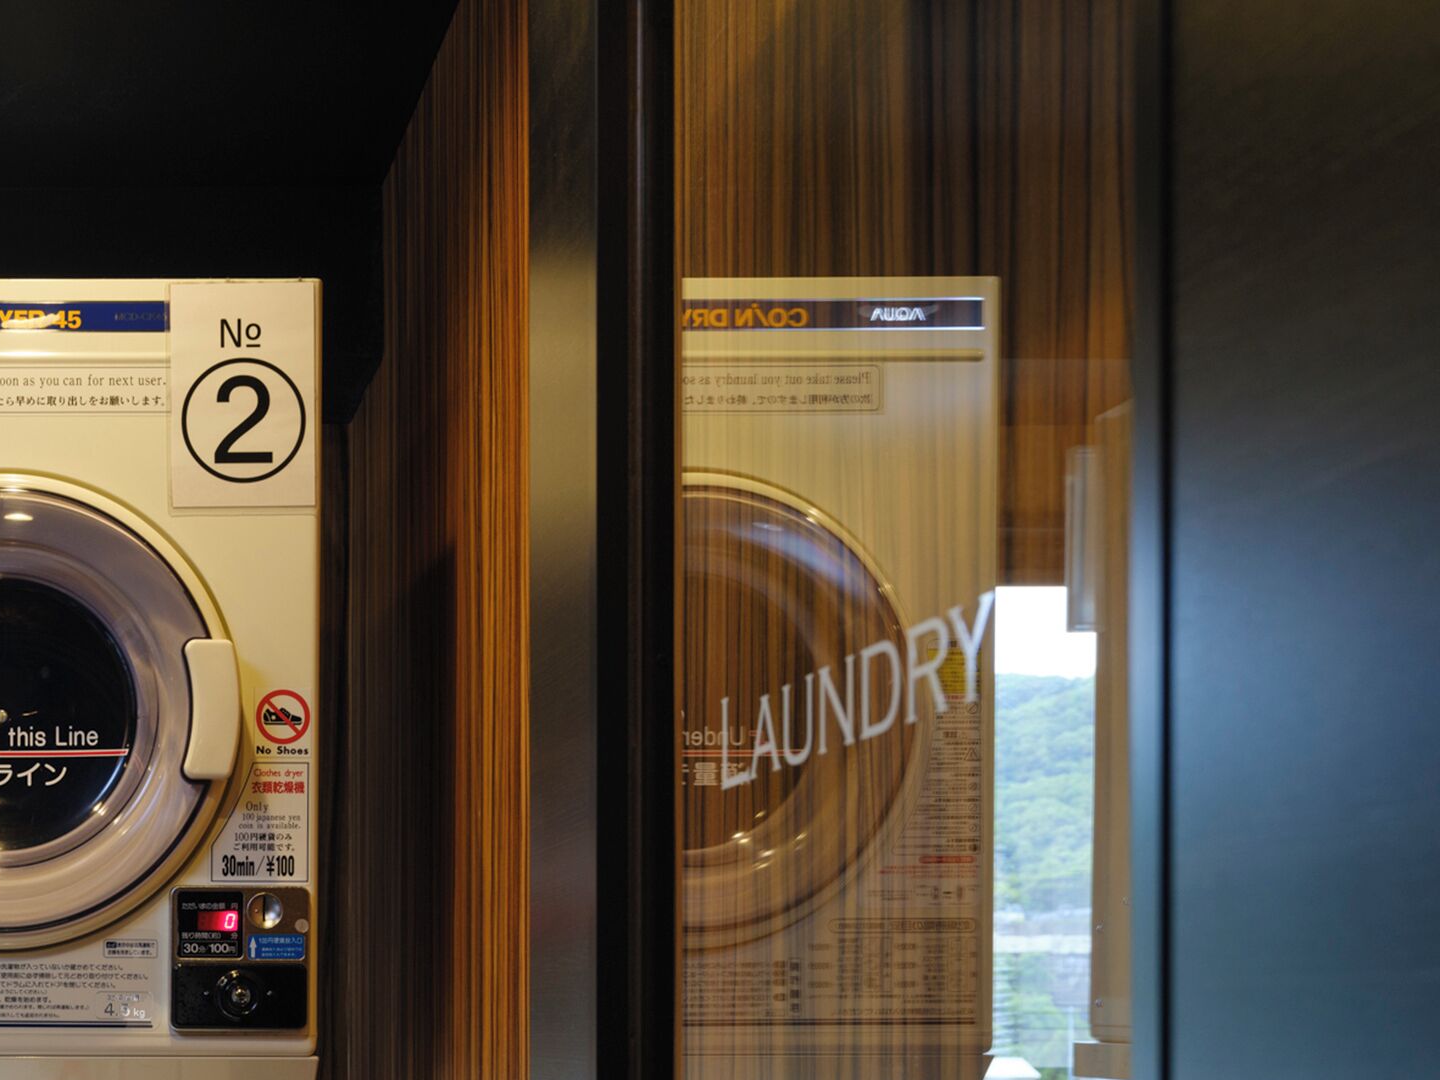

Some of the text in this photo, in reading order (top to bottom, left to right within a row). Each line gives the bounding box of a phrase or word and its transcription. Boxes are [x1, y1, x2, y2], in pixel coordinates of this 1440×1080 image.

[52, 310, 81, 328] 45
[23, 377, 35, 386] as
[40, 377, 59, 389] you
[63, 377, 82, 386] can
[88, 374, 104, 386] for
[109, 376, 133, 386] next
[138, 377, 166, 386] user.
[721, 591, 996, 790] LAUNDRY
[8, 726, 46, 747] this
[55, 725, 98, 746] Line
[256, 746, 309, 756] No Shoes
[254, 769, 304, 779] Clothes dryer
[252, 781, 305, 794] 衣類乾燥機
[245, 802, 269, 812] Only
[224, 913, 236, 929] 0
